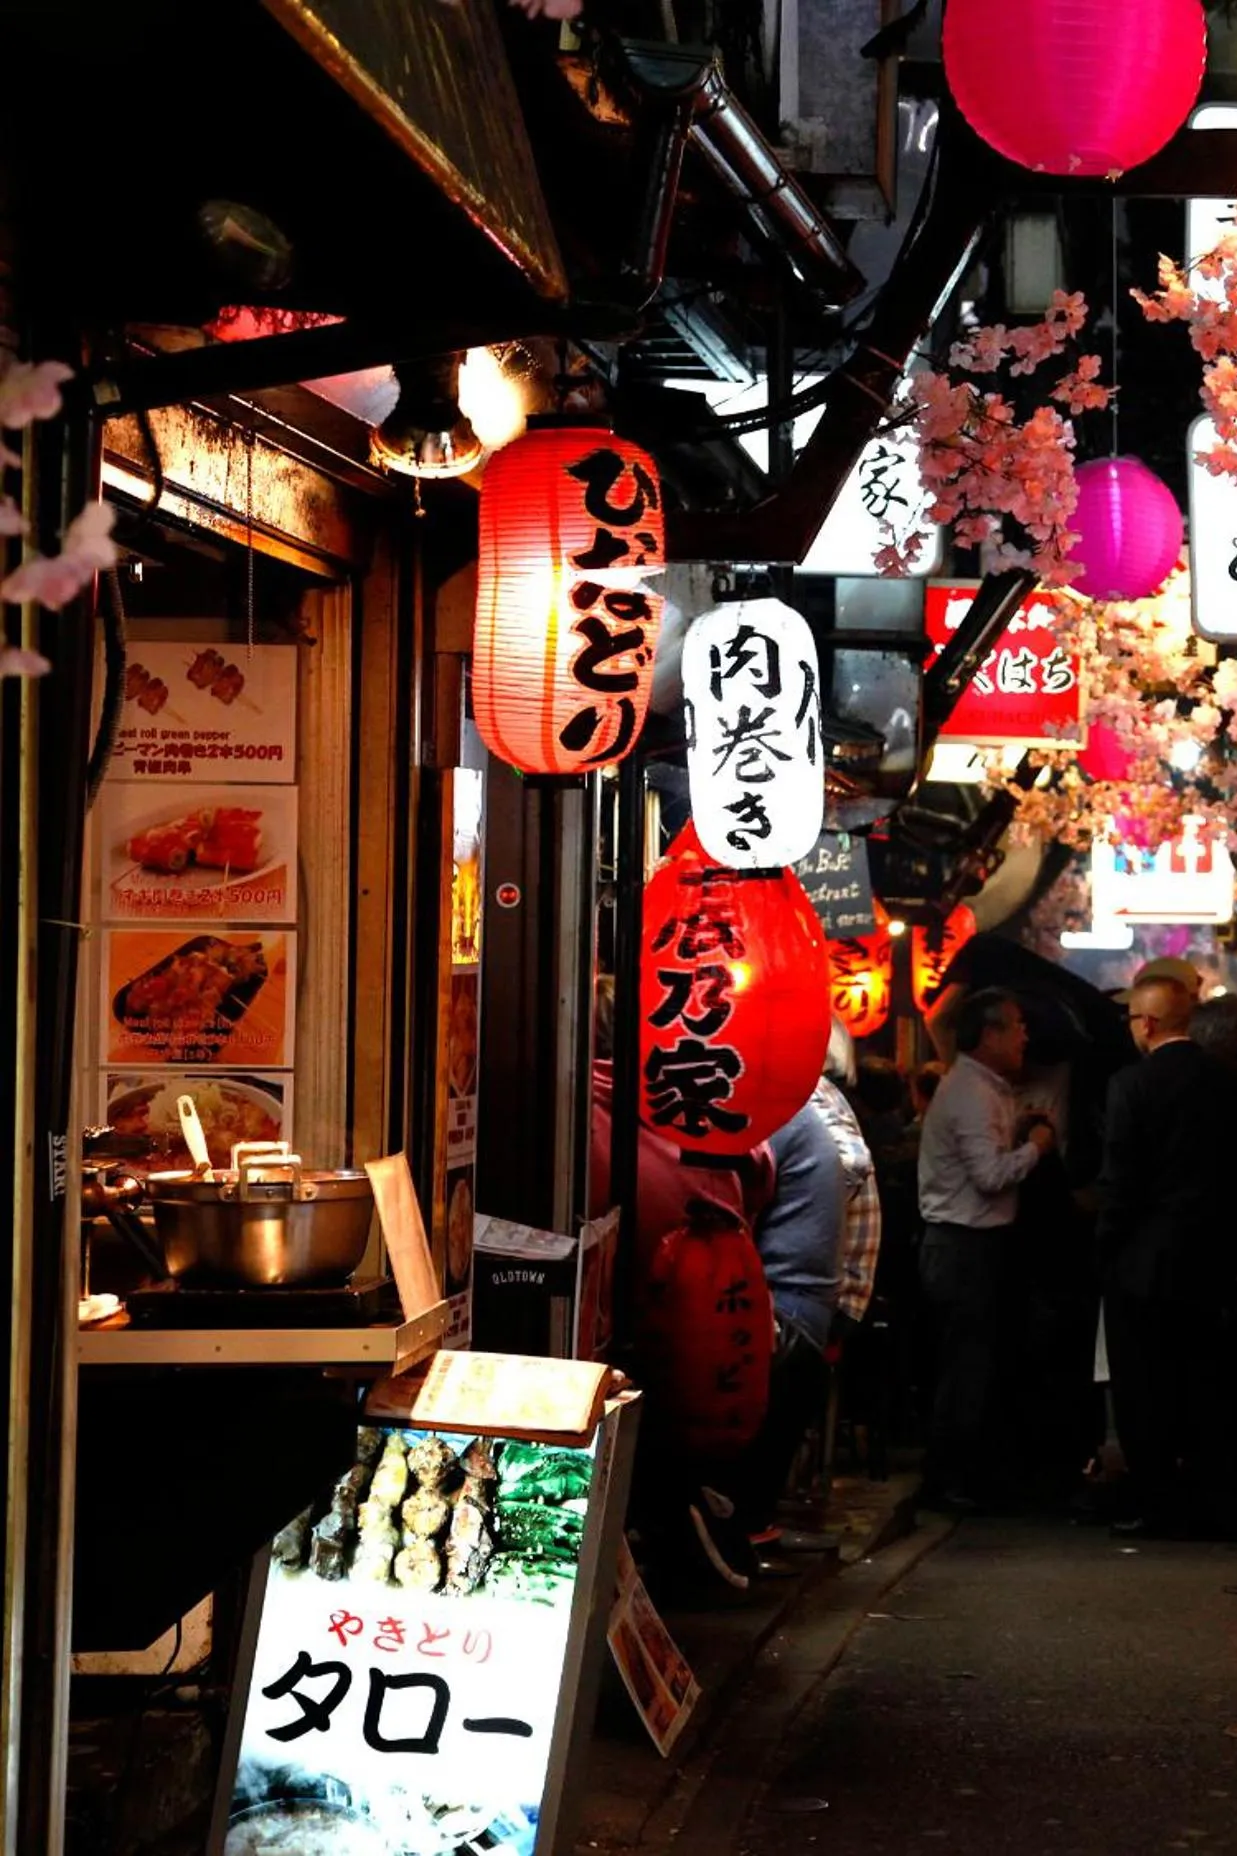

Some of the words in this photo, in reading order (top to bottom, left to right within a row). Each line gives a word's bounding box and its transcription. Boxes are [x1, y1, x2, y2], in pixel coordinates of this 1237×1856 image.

[709, 625, 794, 851] 肉巻き
[491, 1269, 546, 1286] OLDTOWN
[326, 1609, 496, 1664] やきとり
[261, 1650, 534, 1755] タロー
